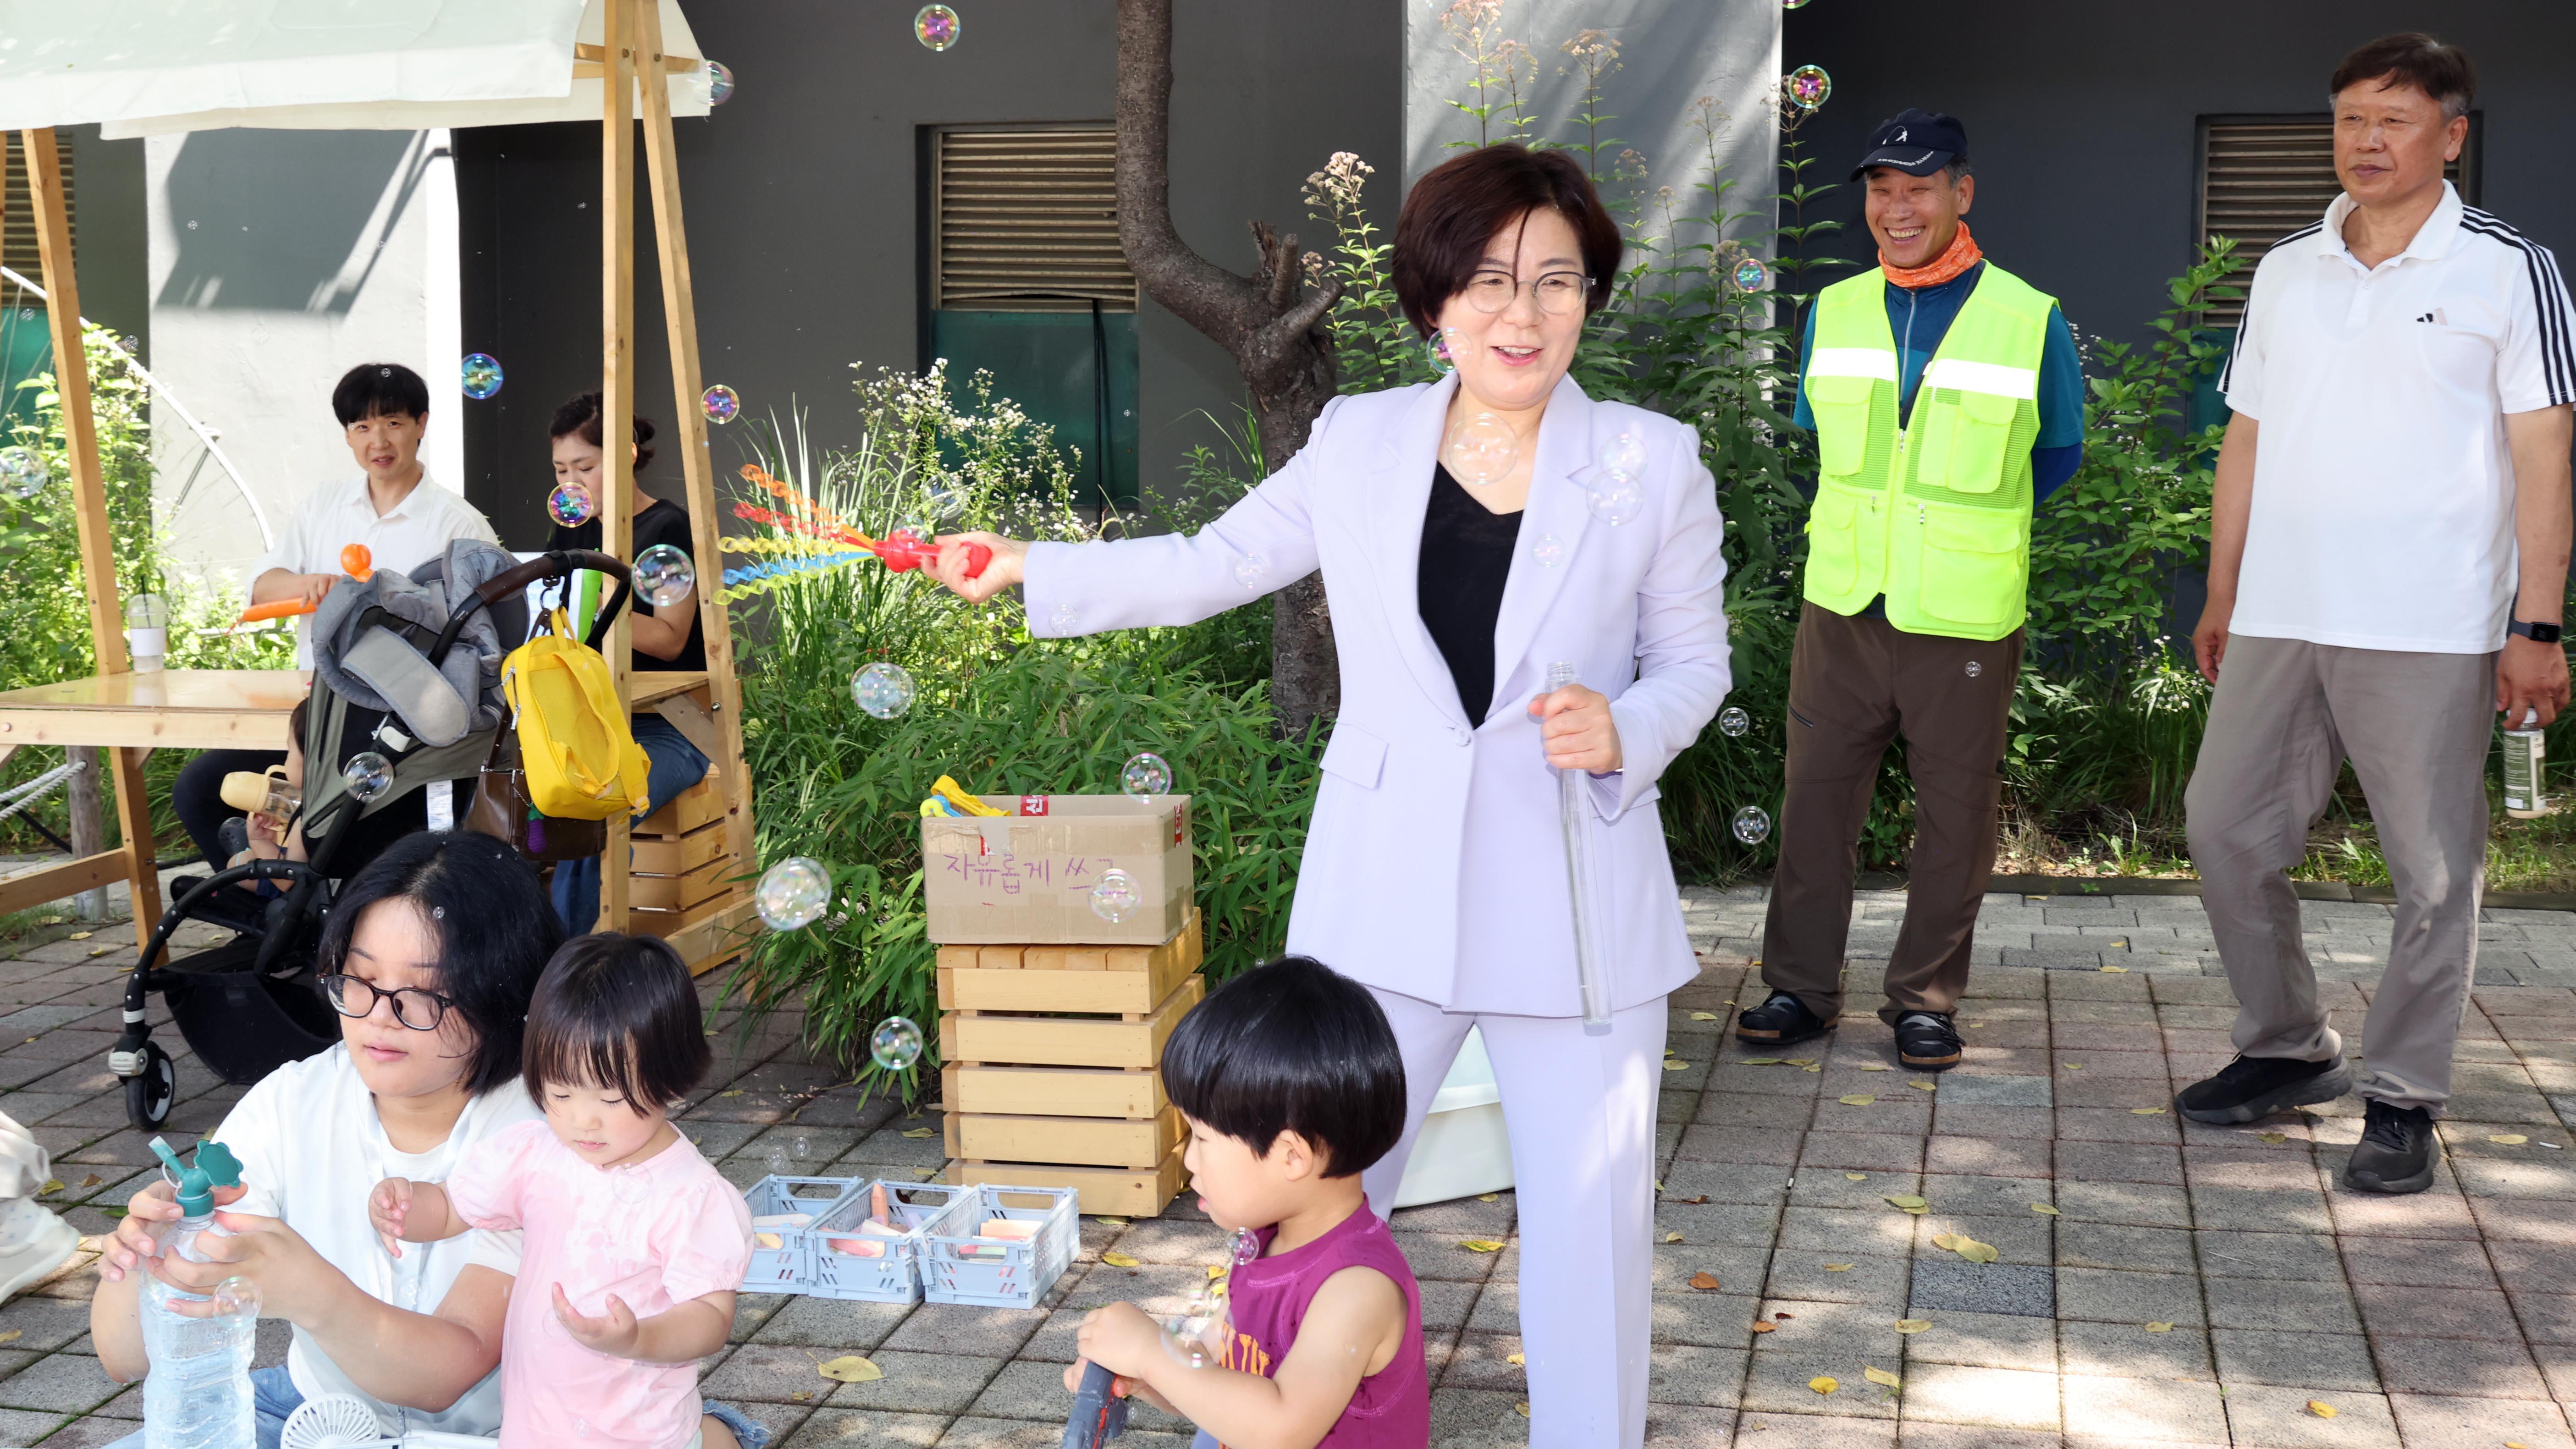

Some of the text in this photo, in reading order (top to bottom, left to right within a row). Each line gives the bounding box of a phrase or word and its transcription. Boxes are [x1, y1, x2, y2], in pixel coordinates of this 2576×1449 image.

[1026, 795, 1043, 814] 신
[943, 853, 1129, 895] 자유롭게 쓰고
